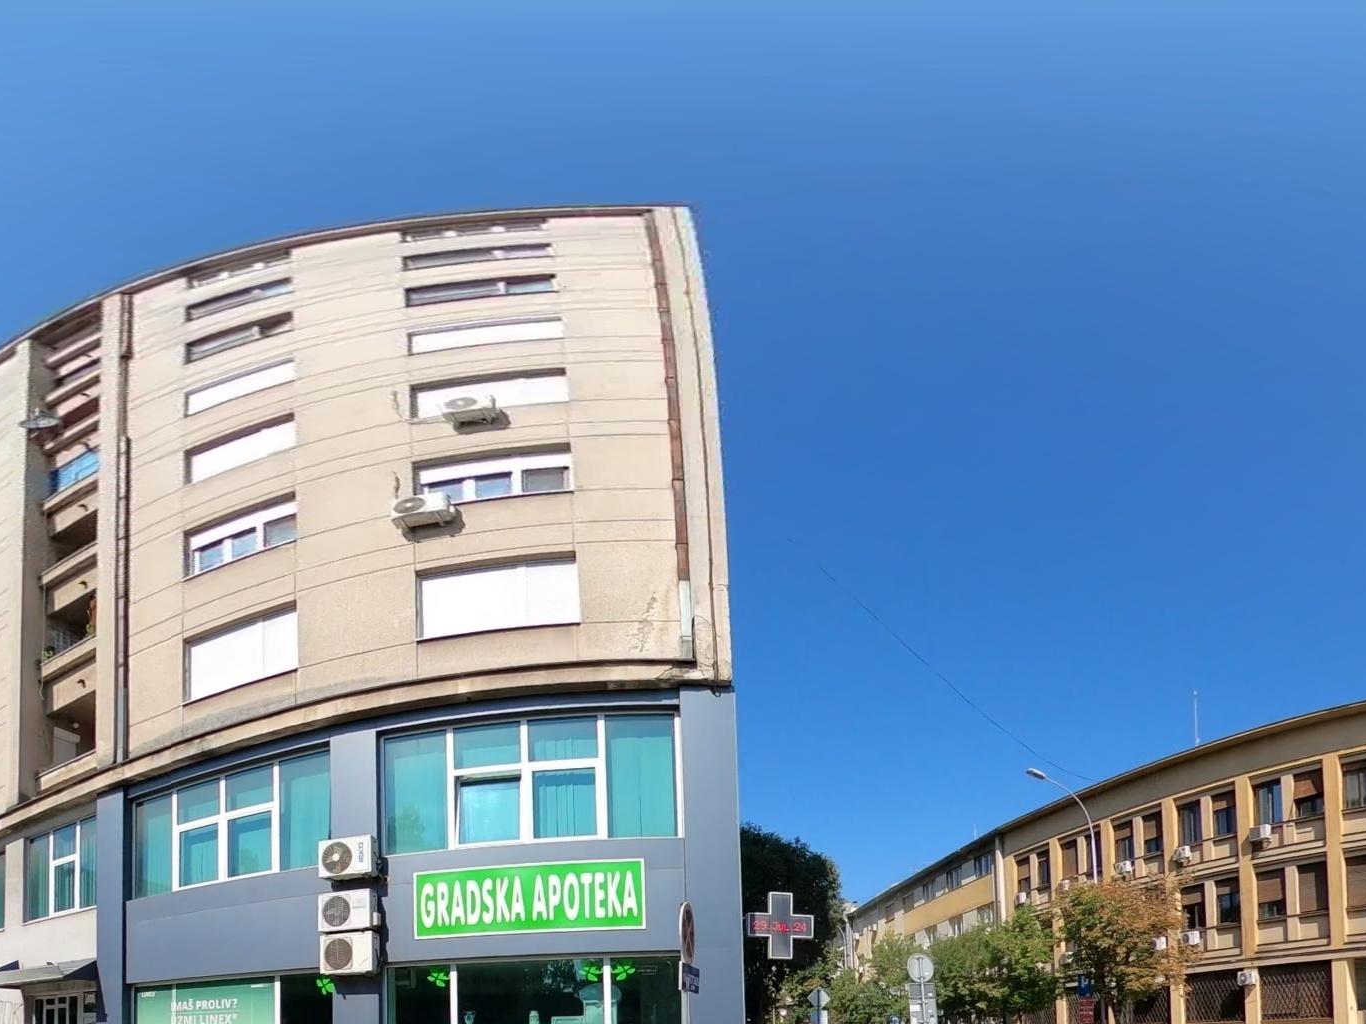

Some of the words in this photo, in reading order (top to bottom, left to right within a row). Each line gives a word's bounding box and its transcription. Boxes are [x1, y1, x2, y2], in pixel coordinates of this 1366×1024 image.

[420, 876, 525, 929] GRADSKA
[531, 870, 639, 921] APOTEKA
[195, 998, 238, 1010] PROLIV?
